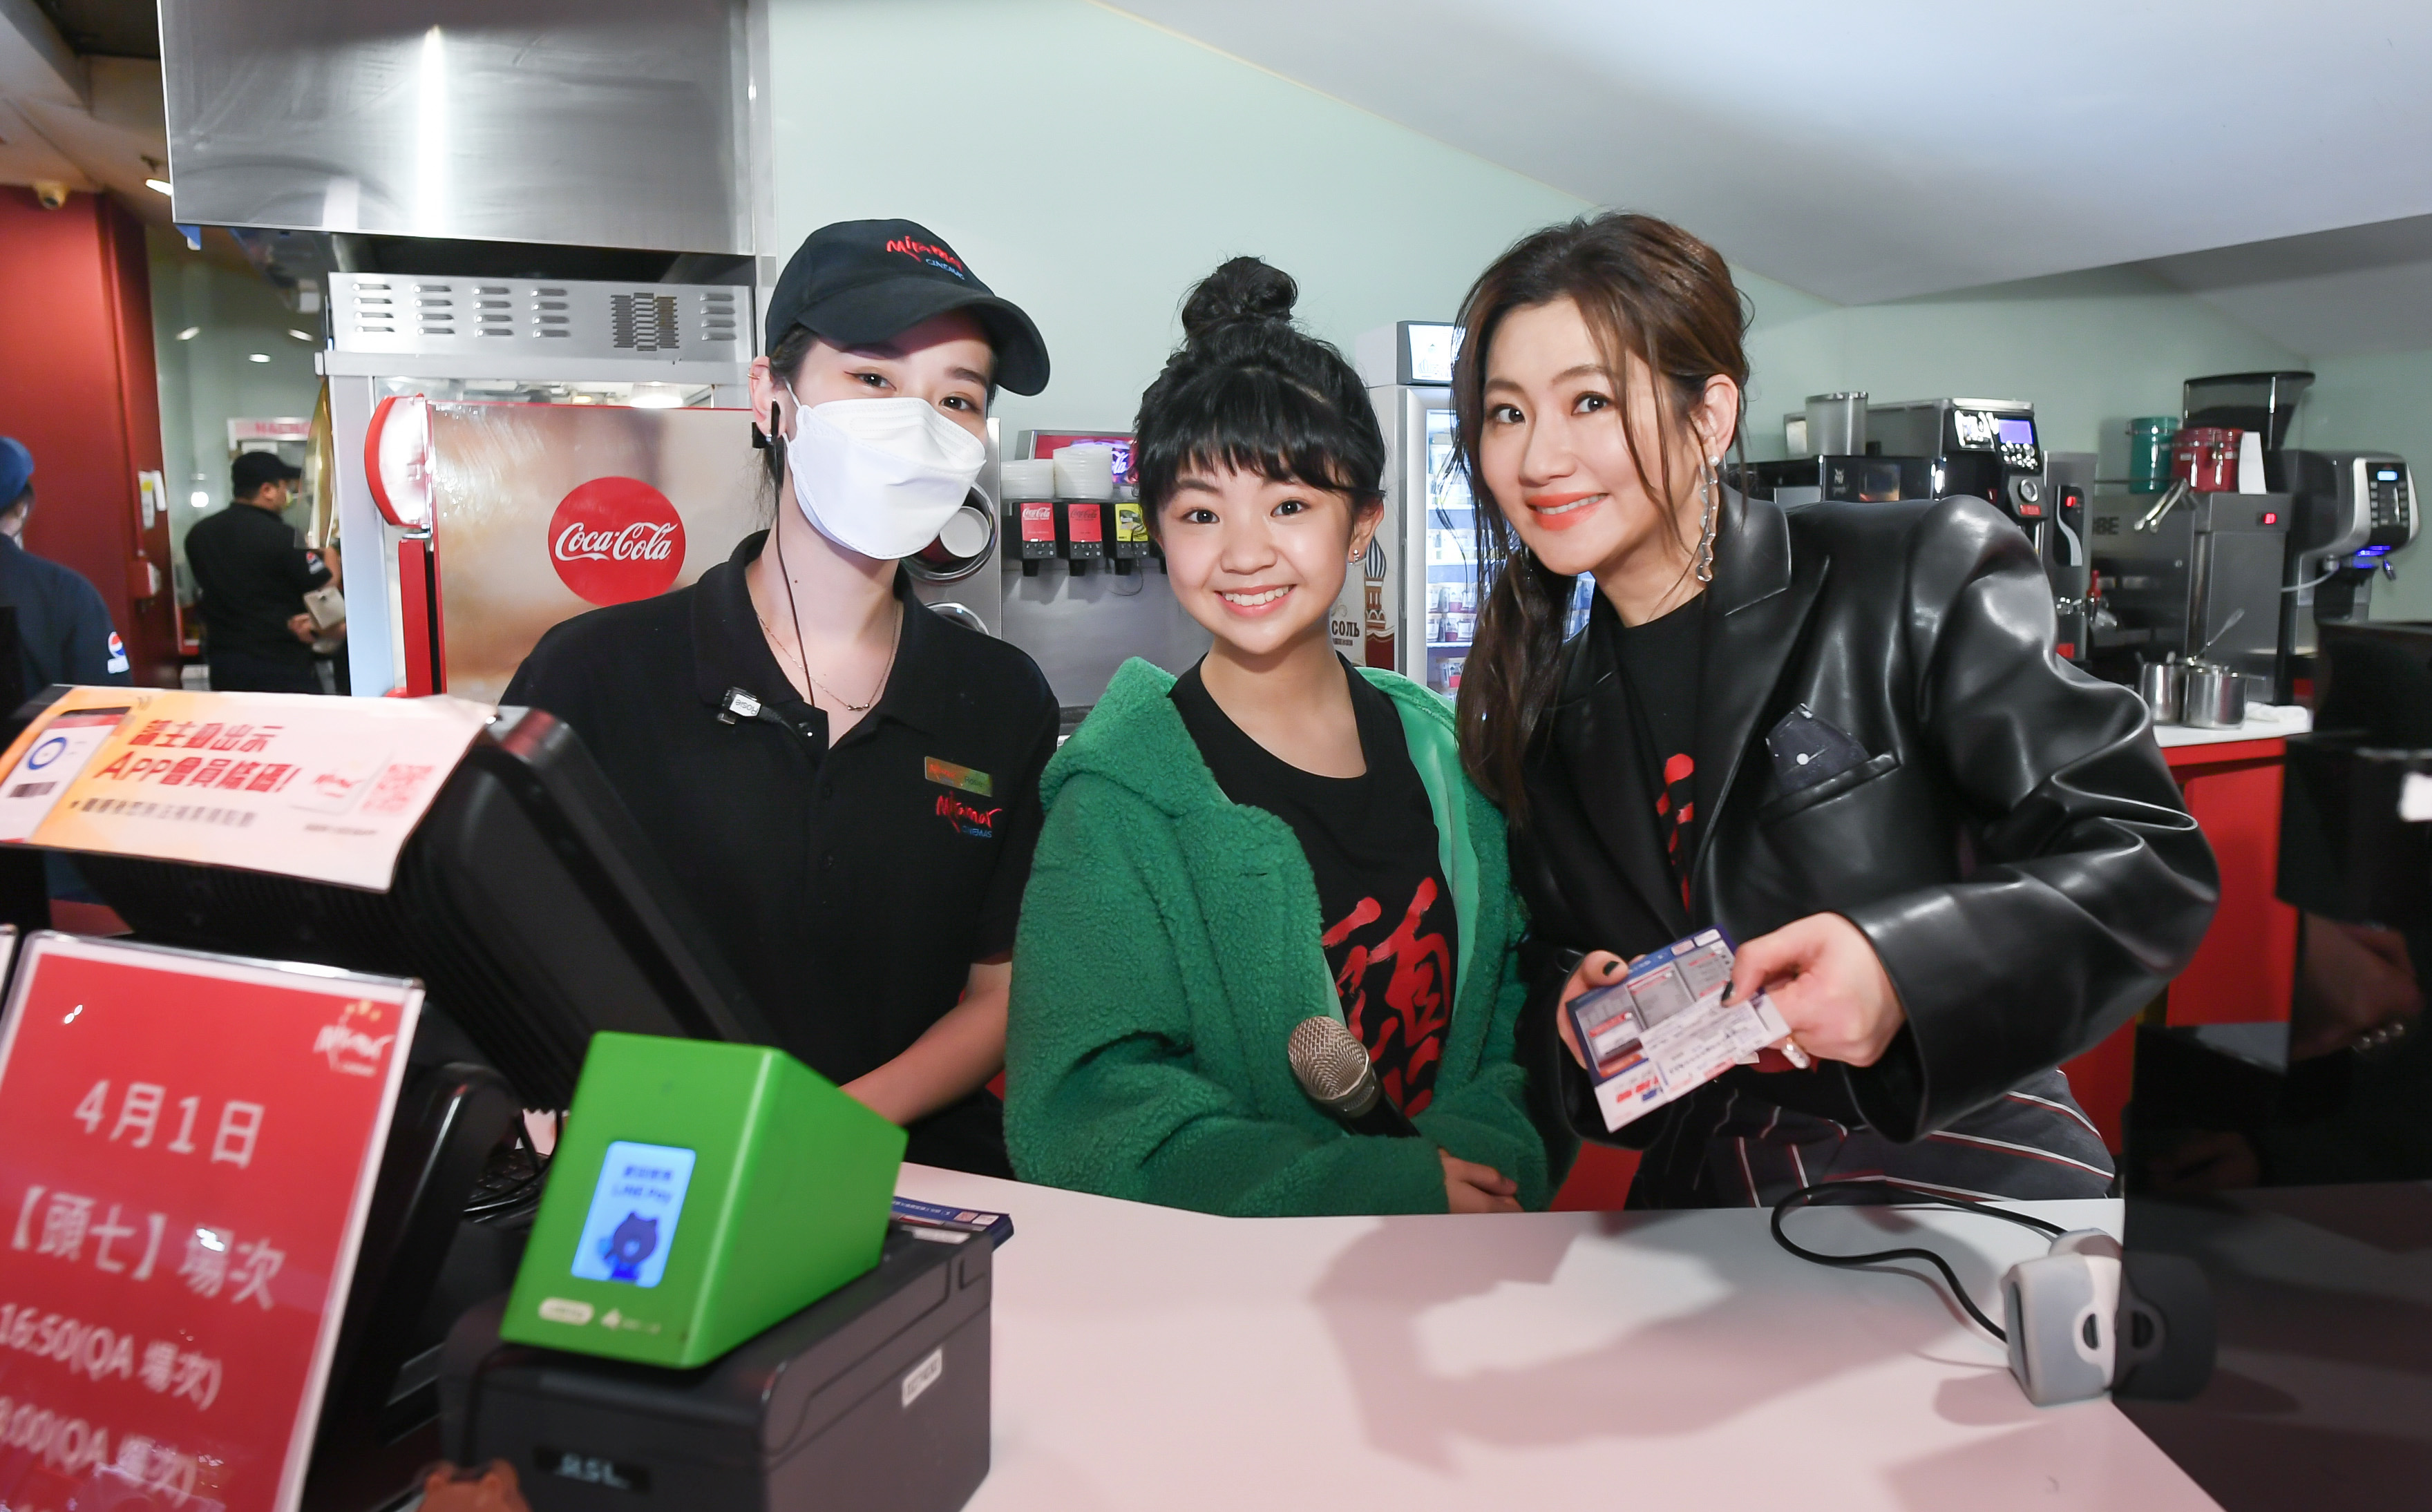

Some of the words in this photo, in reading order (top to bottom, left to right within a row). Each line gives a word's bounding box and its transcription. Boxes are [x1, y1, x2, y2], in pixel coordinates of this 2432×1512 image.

[555, 521, 678, 561] Coca-Cola
[1331, 620, 1360, 638] СОЛЬ
[73, 1079, 265, 1169] 4月1日
